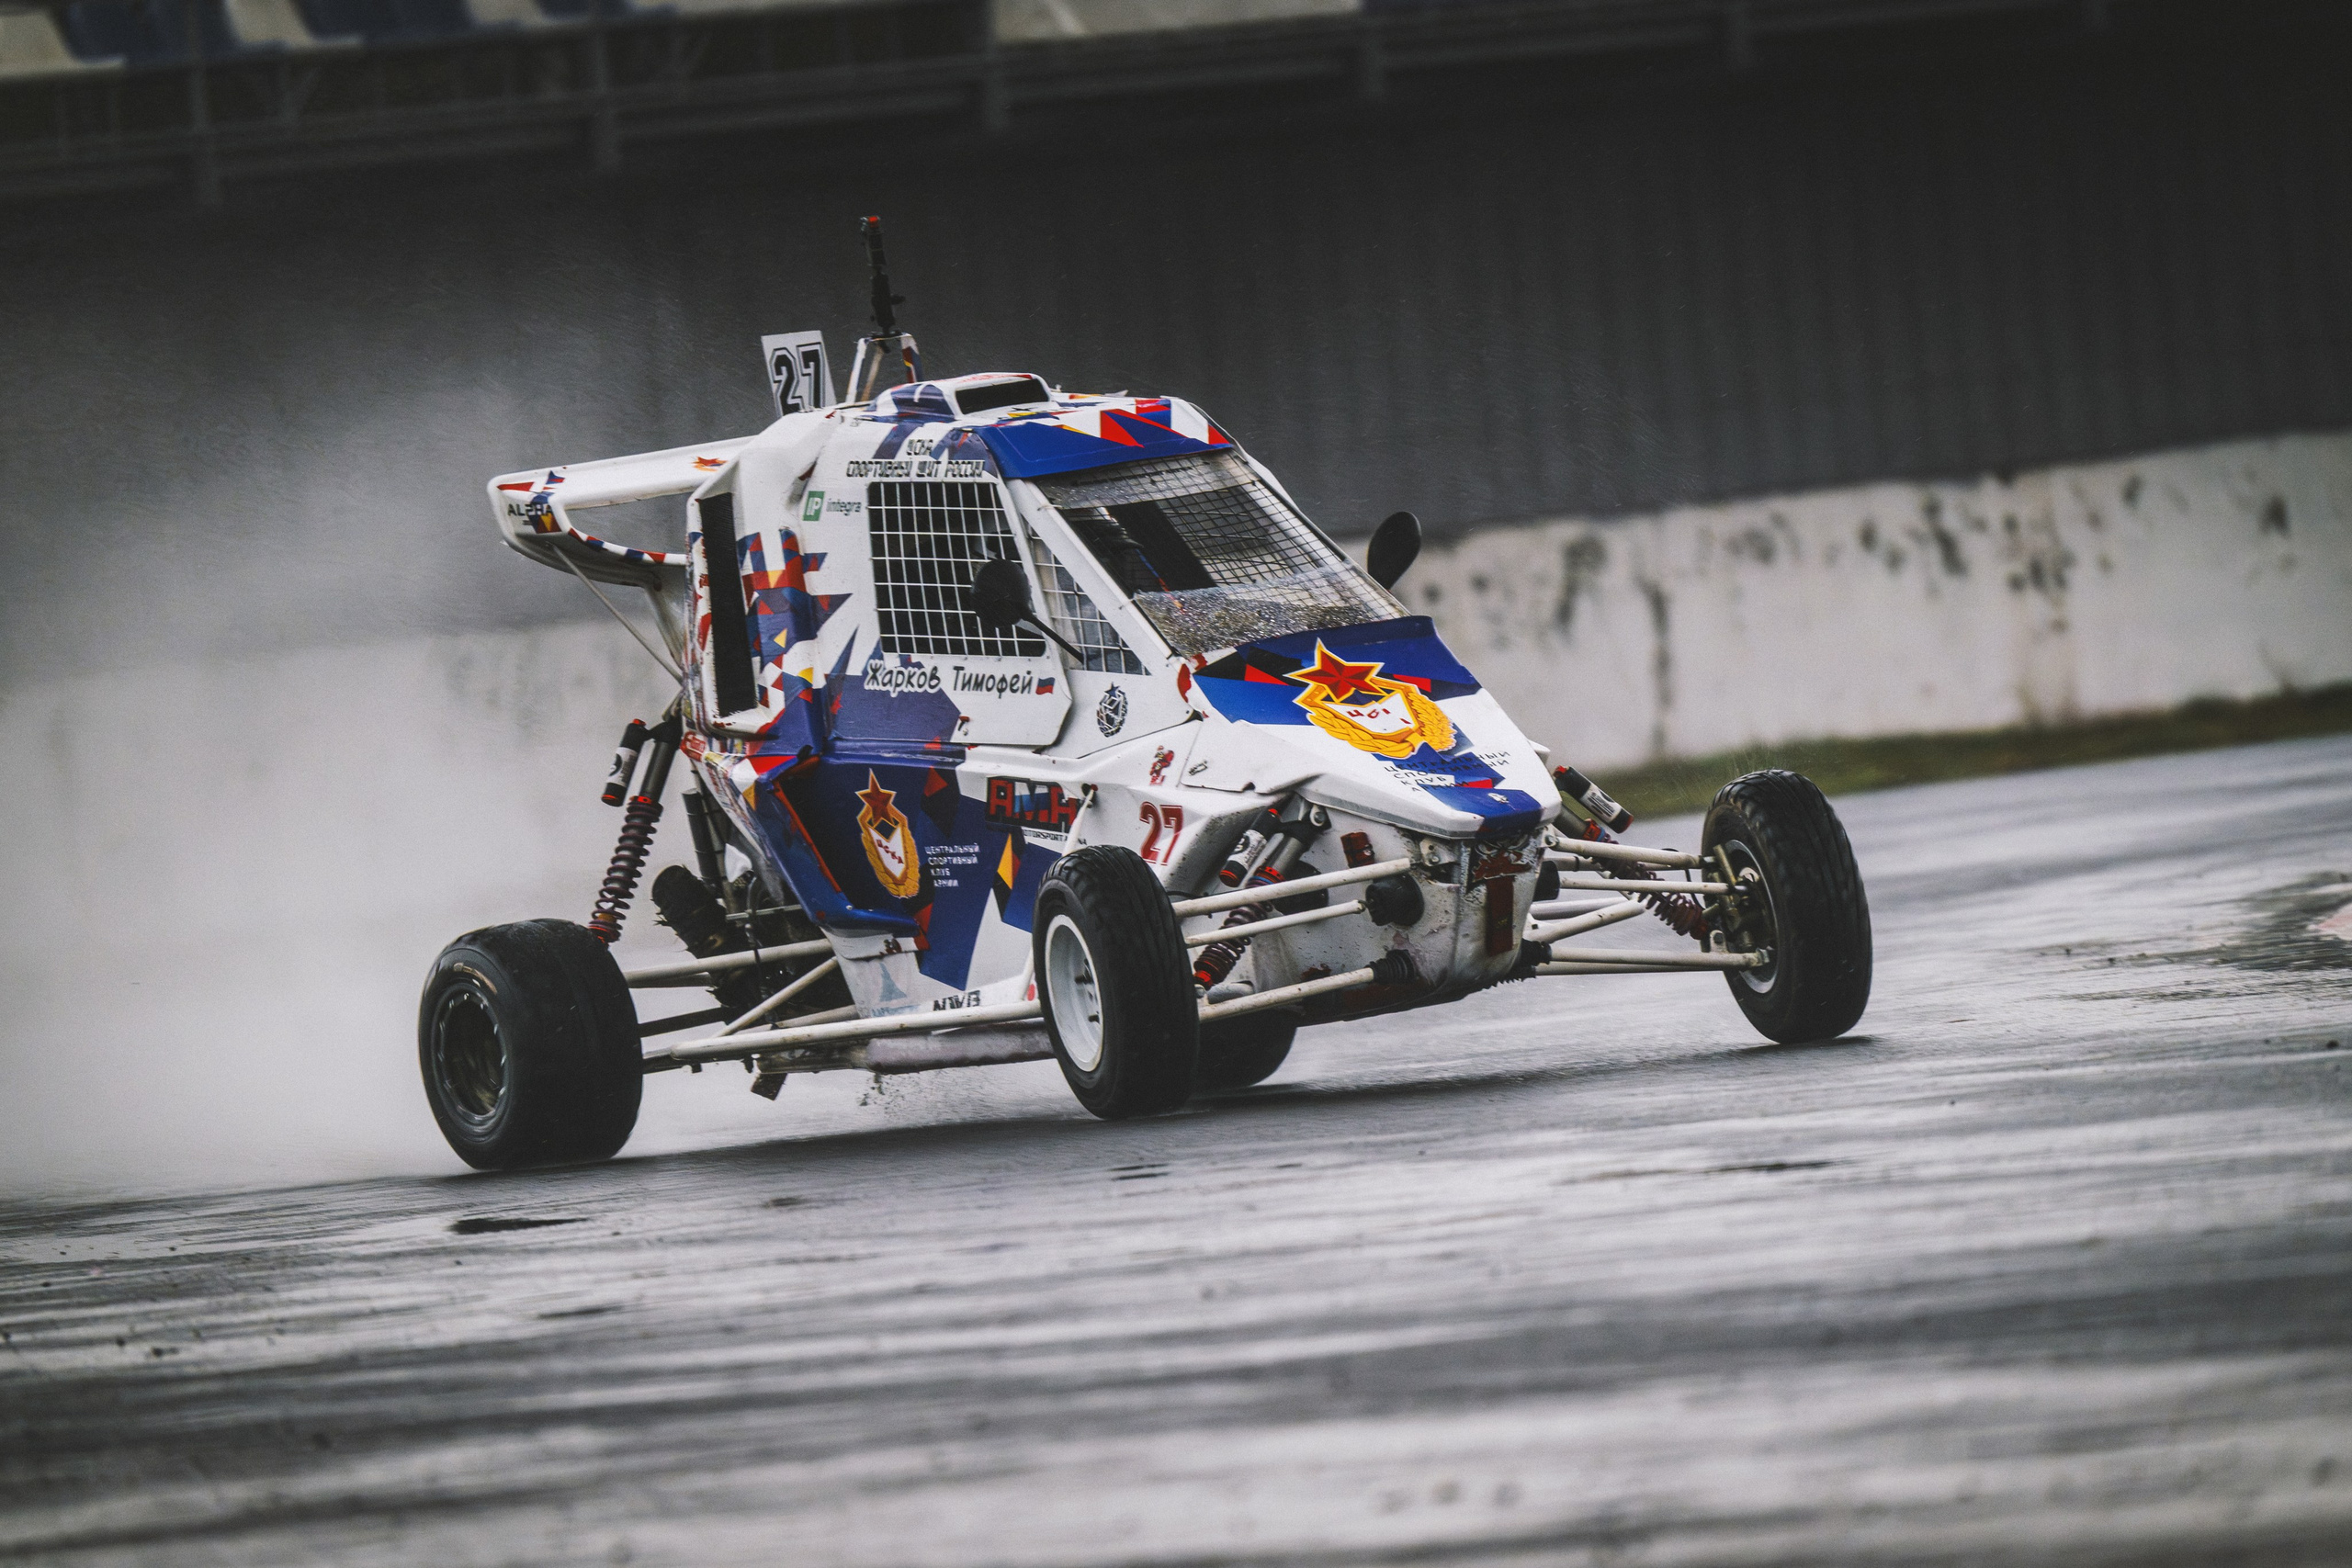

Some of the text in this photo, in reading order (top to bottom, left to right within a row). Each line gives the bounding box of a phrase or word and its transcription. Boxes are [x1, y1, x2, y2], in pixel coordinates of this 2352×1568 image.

[770, 341, 826, 416] 27
[866, 662, 1033, 699] Жарков Тимофей
[928, 853, 978, 865] СПОРТИВНЫЙ
[1138, 801, 1183, 866] 27
